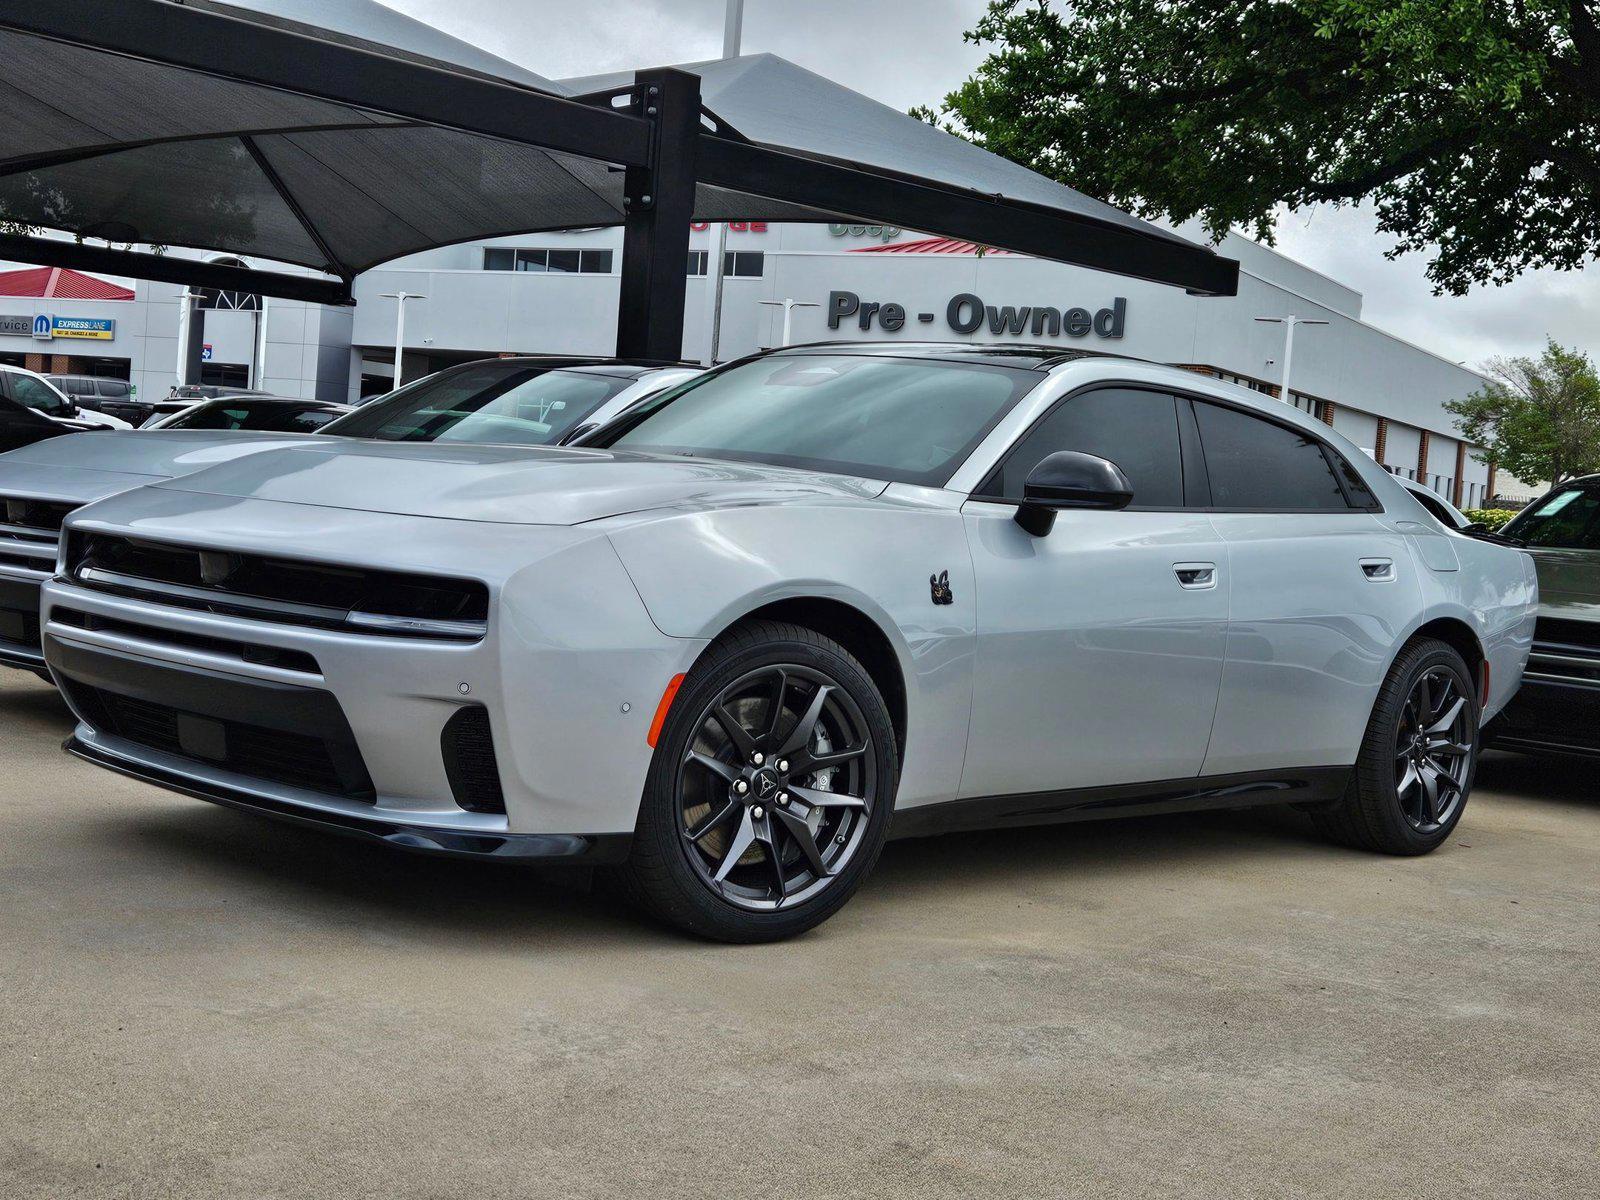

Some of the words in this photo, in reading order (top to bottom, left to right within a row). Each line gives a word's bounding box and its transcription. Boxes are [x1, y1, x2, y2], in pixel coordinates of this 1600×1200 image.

[829, 290, 906, 331] Pre
[918, 313, 935, 323] -
[947, 293, 1127, 339] Owned
